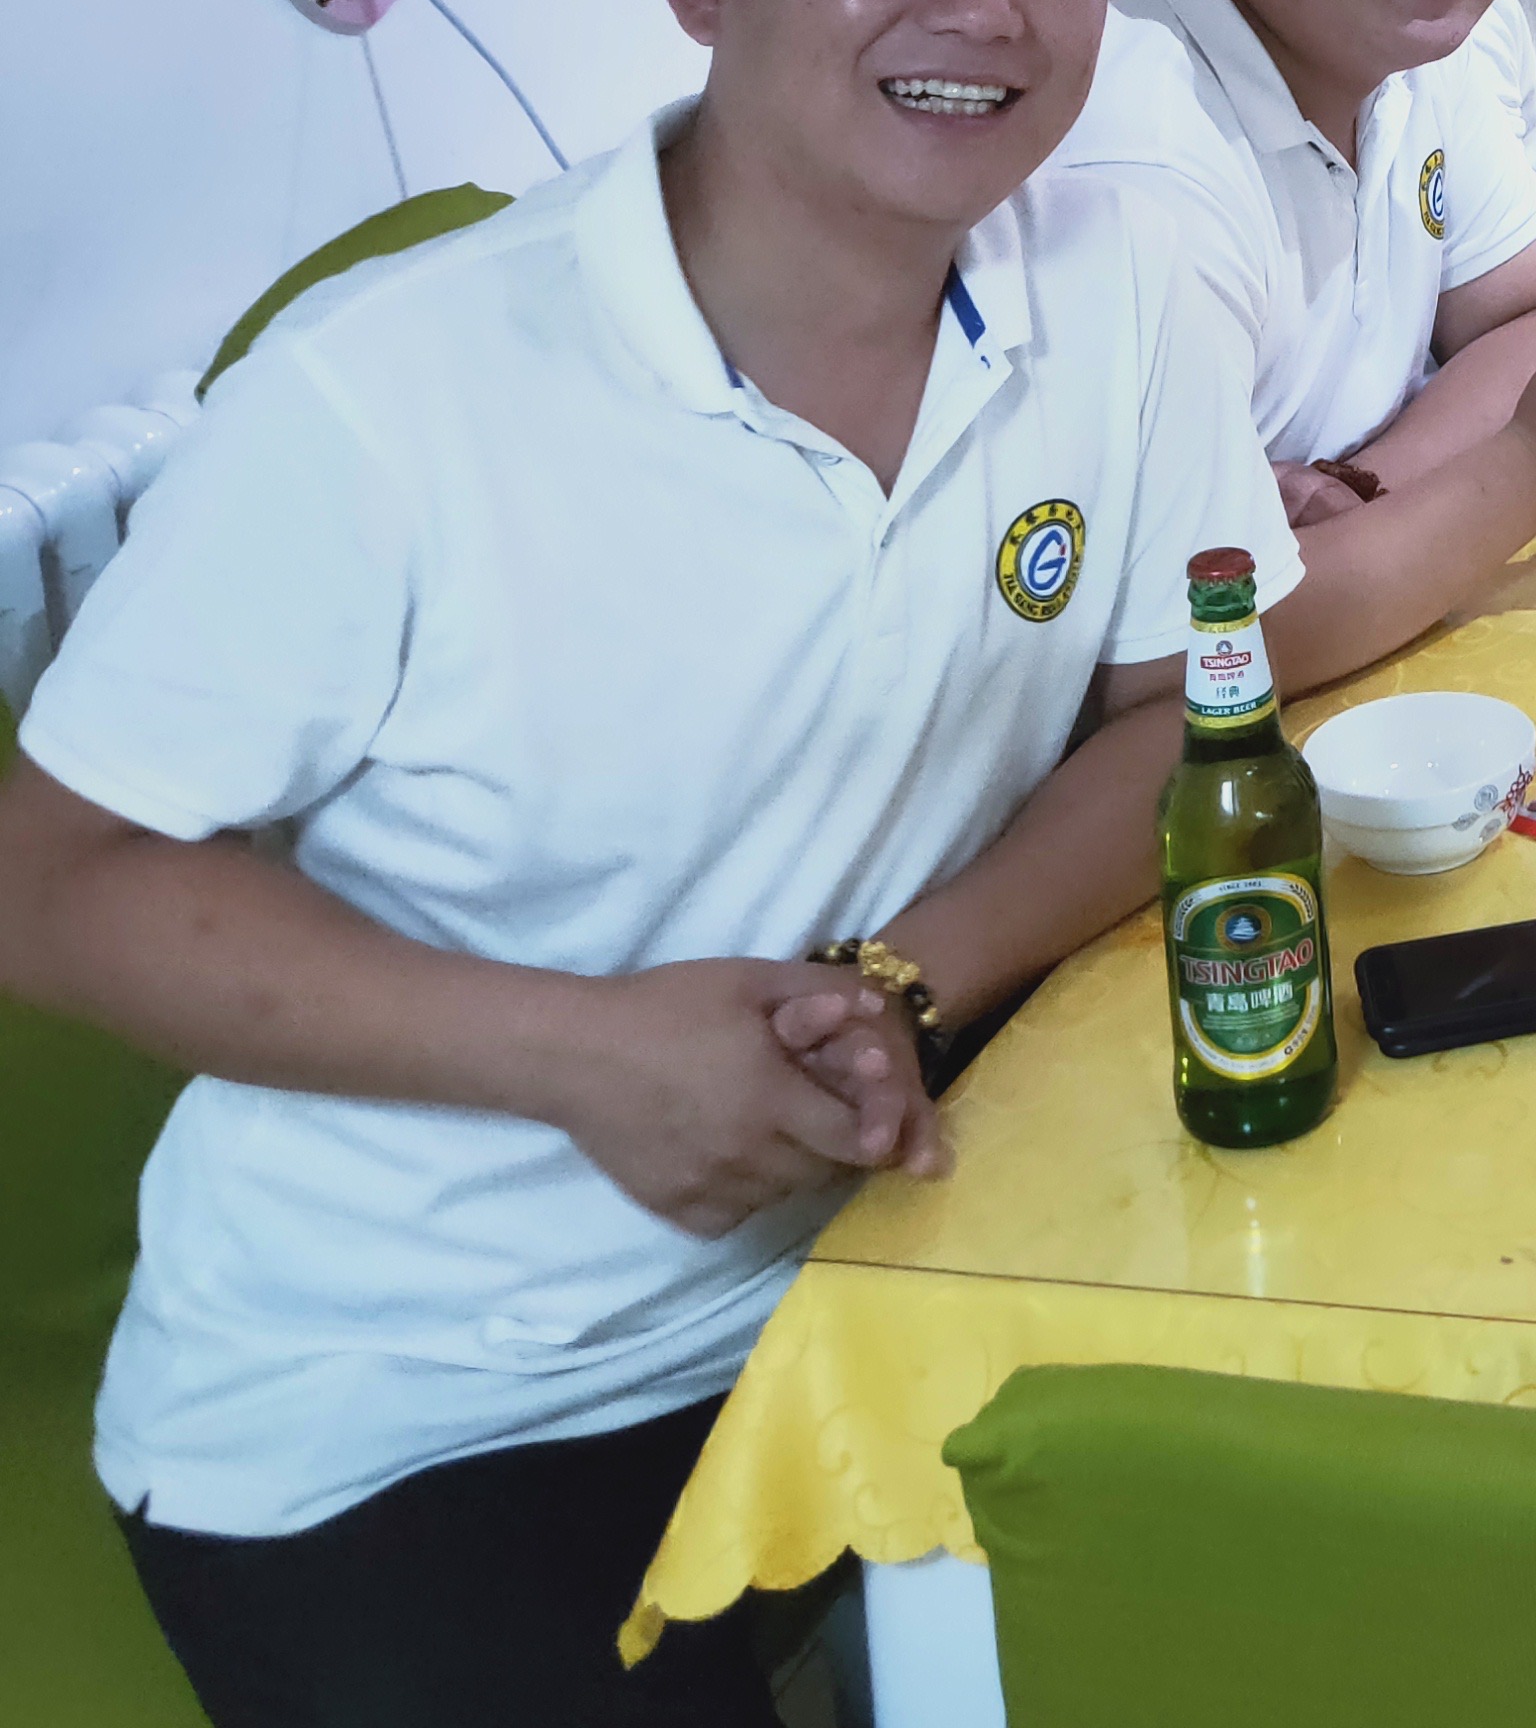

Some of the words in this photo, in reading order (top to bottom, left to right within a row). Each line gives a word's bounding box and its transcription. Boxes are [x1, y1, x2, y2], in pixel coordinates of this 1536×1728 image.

[1203, 654, 1250, 668] TSINGTAO
[1201, 706, 1231, 716] LAGER
[1233, 701, 1257, 714] BEER
[1180, 937, 1314, 987] TSINGTAO
[1206, 981, 1294, 1013] 青岛啤酒
